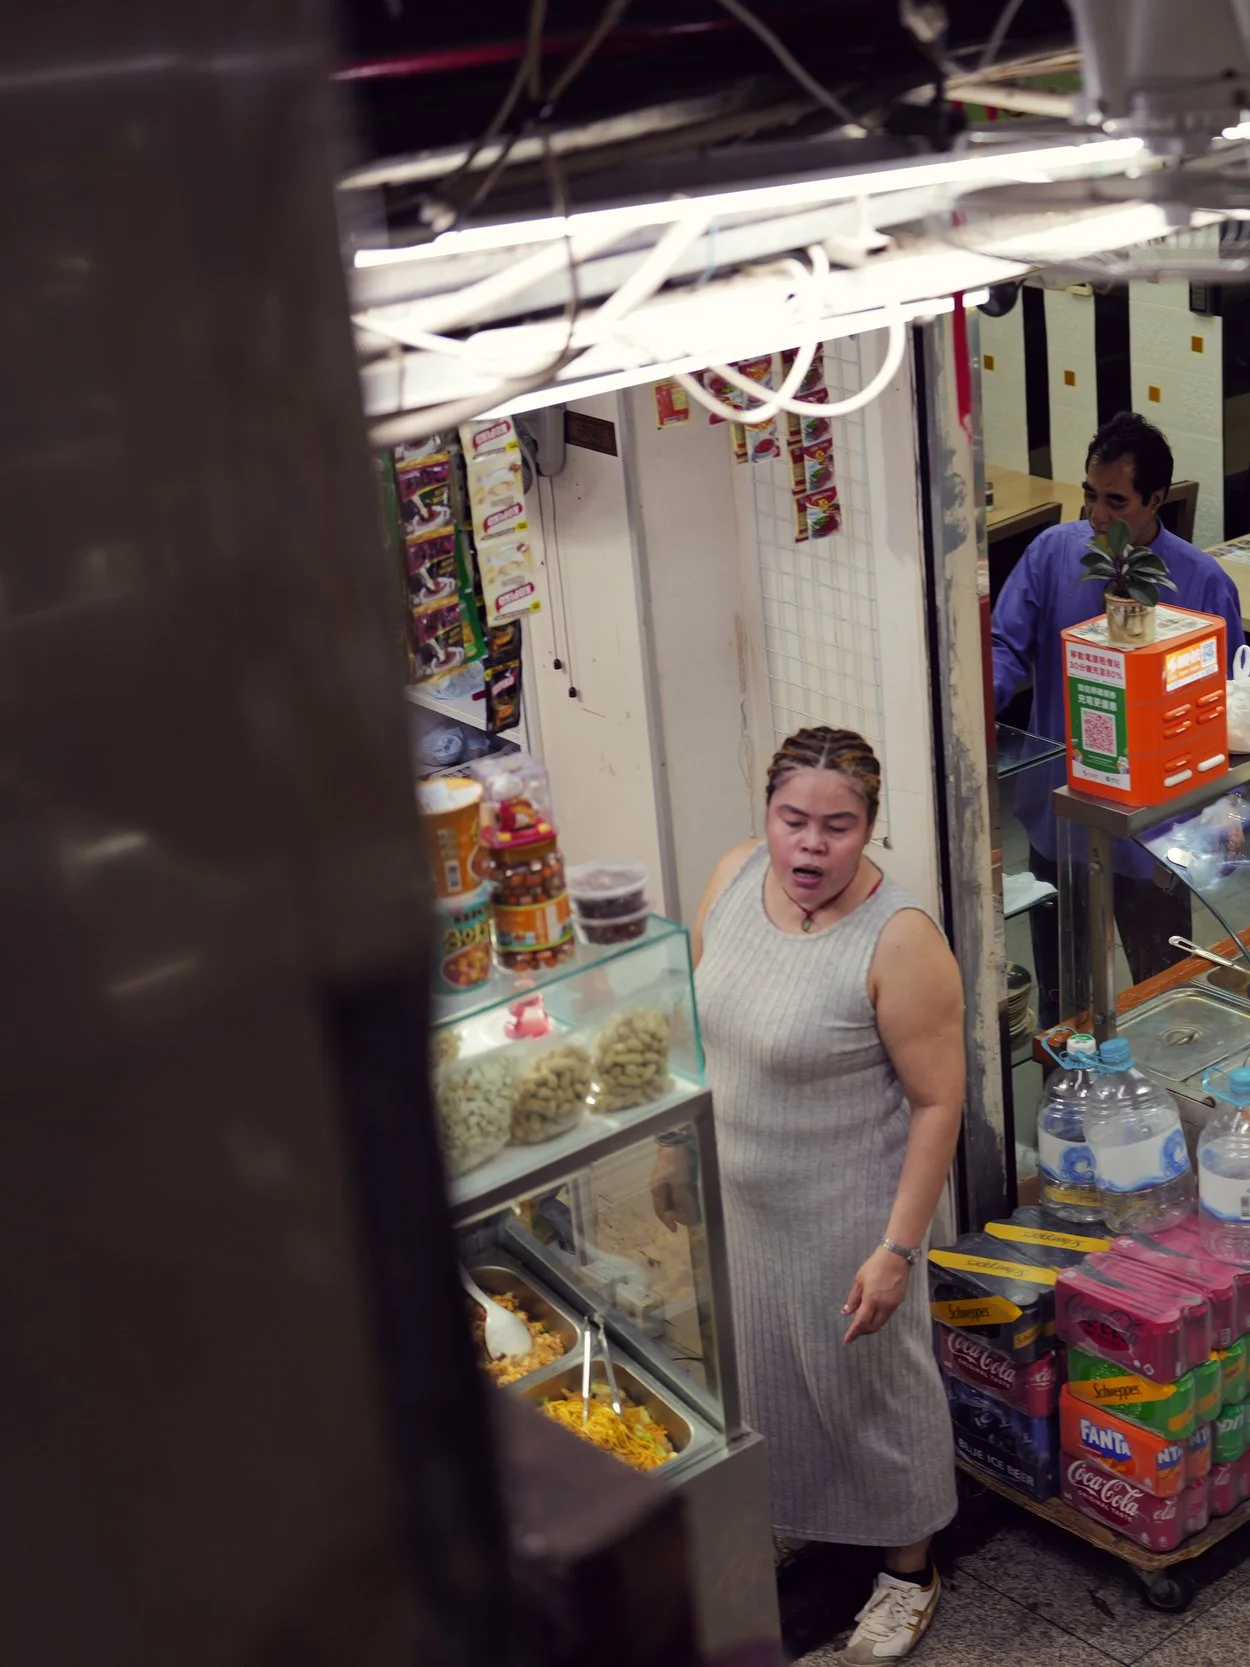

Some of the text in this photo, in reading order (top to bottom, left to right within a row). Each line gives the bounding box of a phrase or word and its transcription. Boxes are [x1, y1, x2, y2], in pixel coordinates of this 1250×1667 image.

[948, 1305, 990, 1321] Schweppes
[1093, 1383, 1141, 1400] Schweppes
[1080, 1418, 1131, 1456] FANTA
[957, 1437, 1035, 1487] BLUE ICE BEER
[1067, 1460, 1144, 1516] Coca-Cola
[1077, 1490, 1133, 1523] ORIGINAL TASTE
